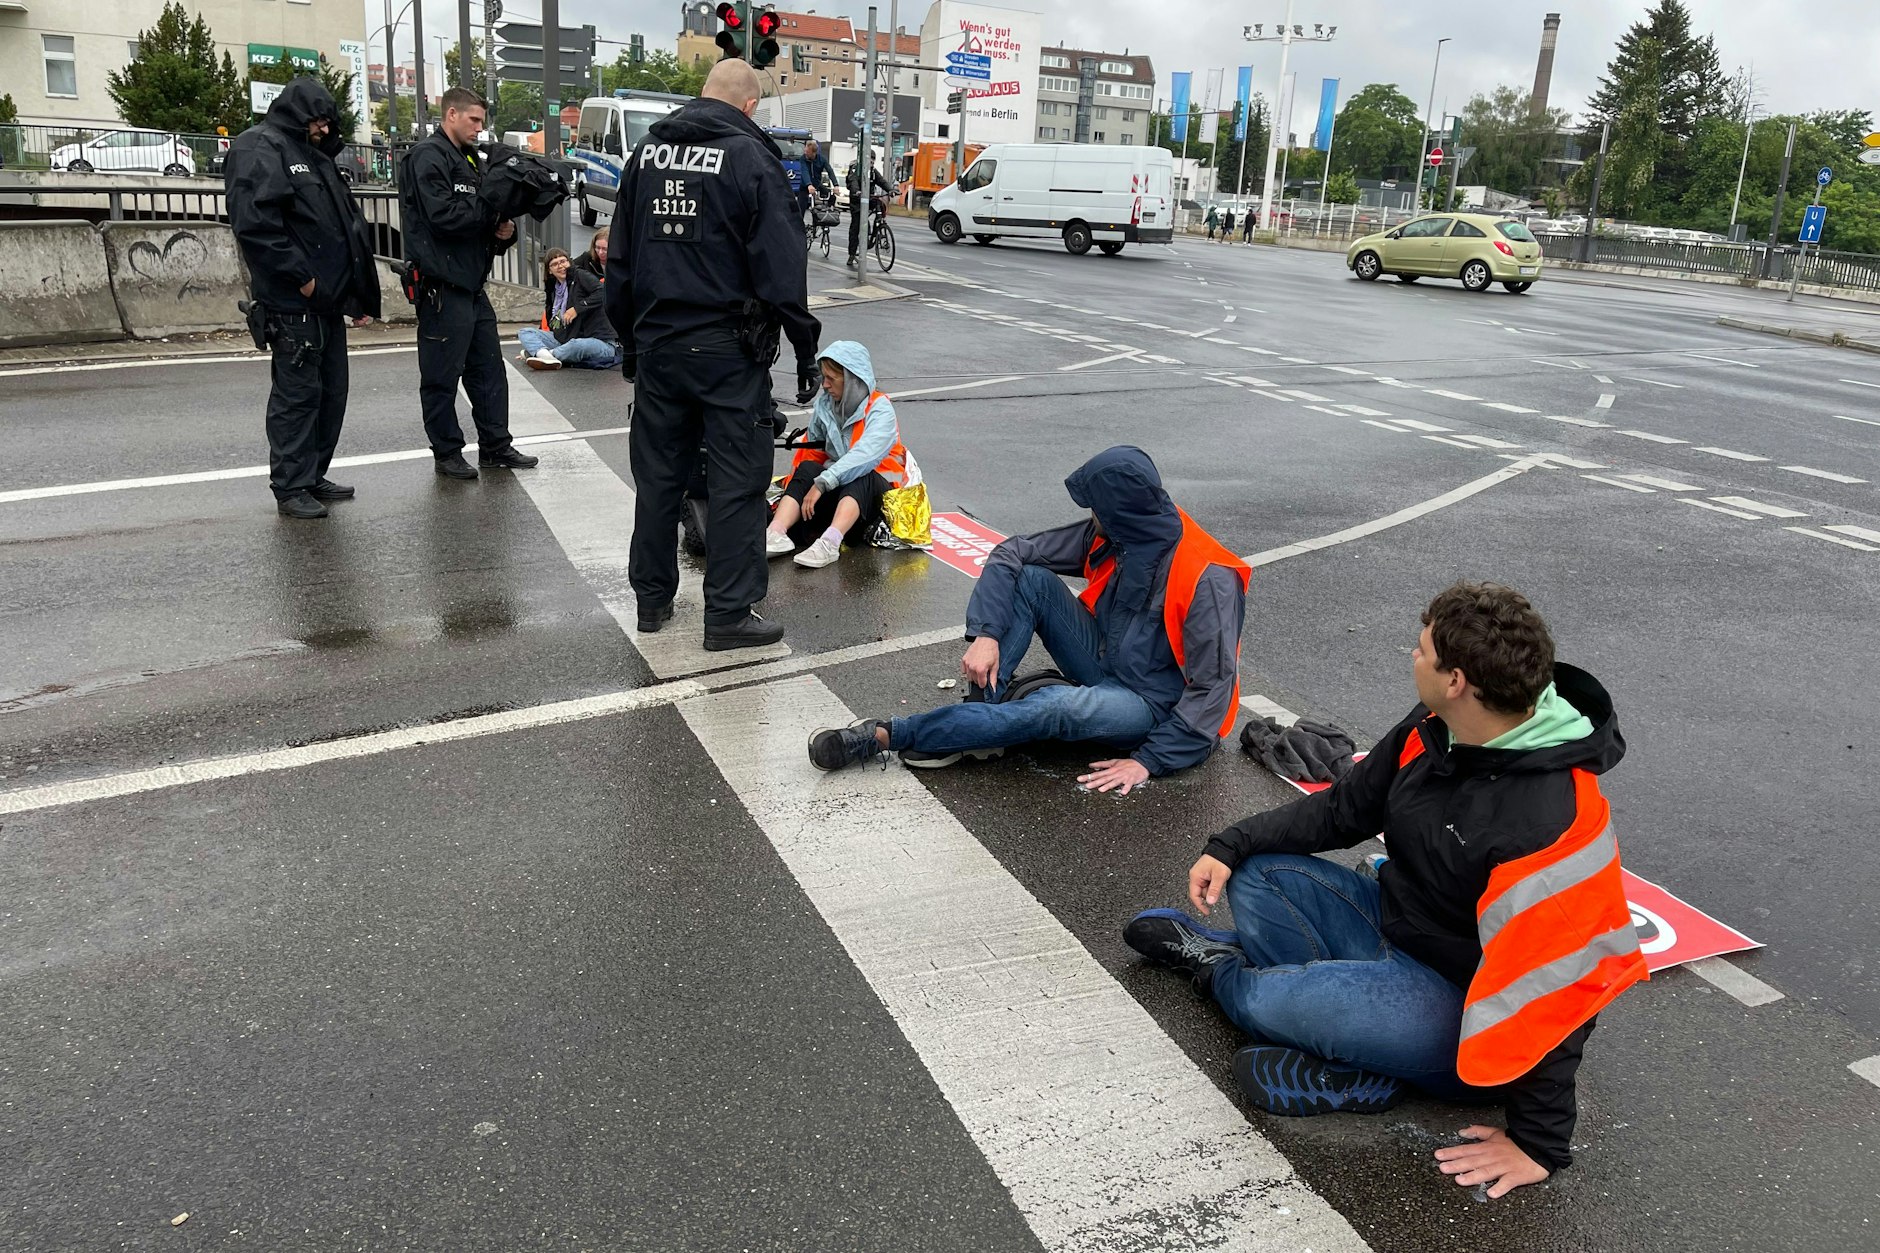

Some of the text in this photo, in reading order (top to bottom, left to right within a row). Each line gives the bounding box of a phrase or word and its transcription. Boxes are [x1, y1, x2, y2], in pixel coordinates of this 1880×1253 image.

[960, 20, 1011, 39] Wenn's gut
[984, 39, 1021, 52] werden
[252, 54, 274, 64] KFZ
[984, 50, 1010, 60] muss.
[983, 110, 990, 118] in
[991, 108, 1018, 120] Berlin
[640, 143, 725, 175] POLIZEI
[665, 179, 685, 197] BE
[652, 198, 697, 216] 13112
[1811, 211, 1819, 220] U
